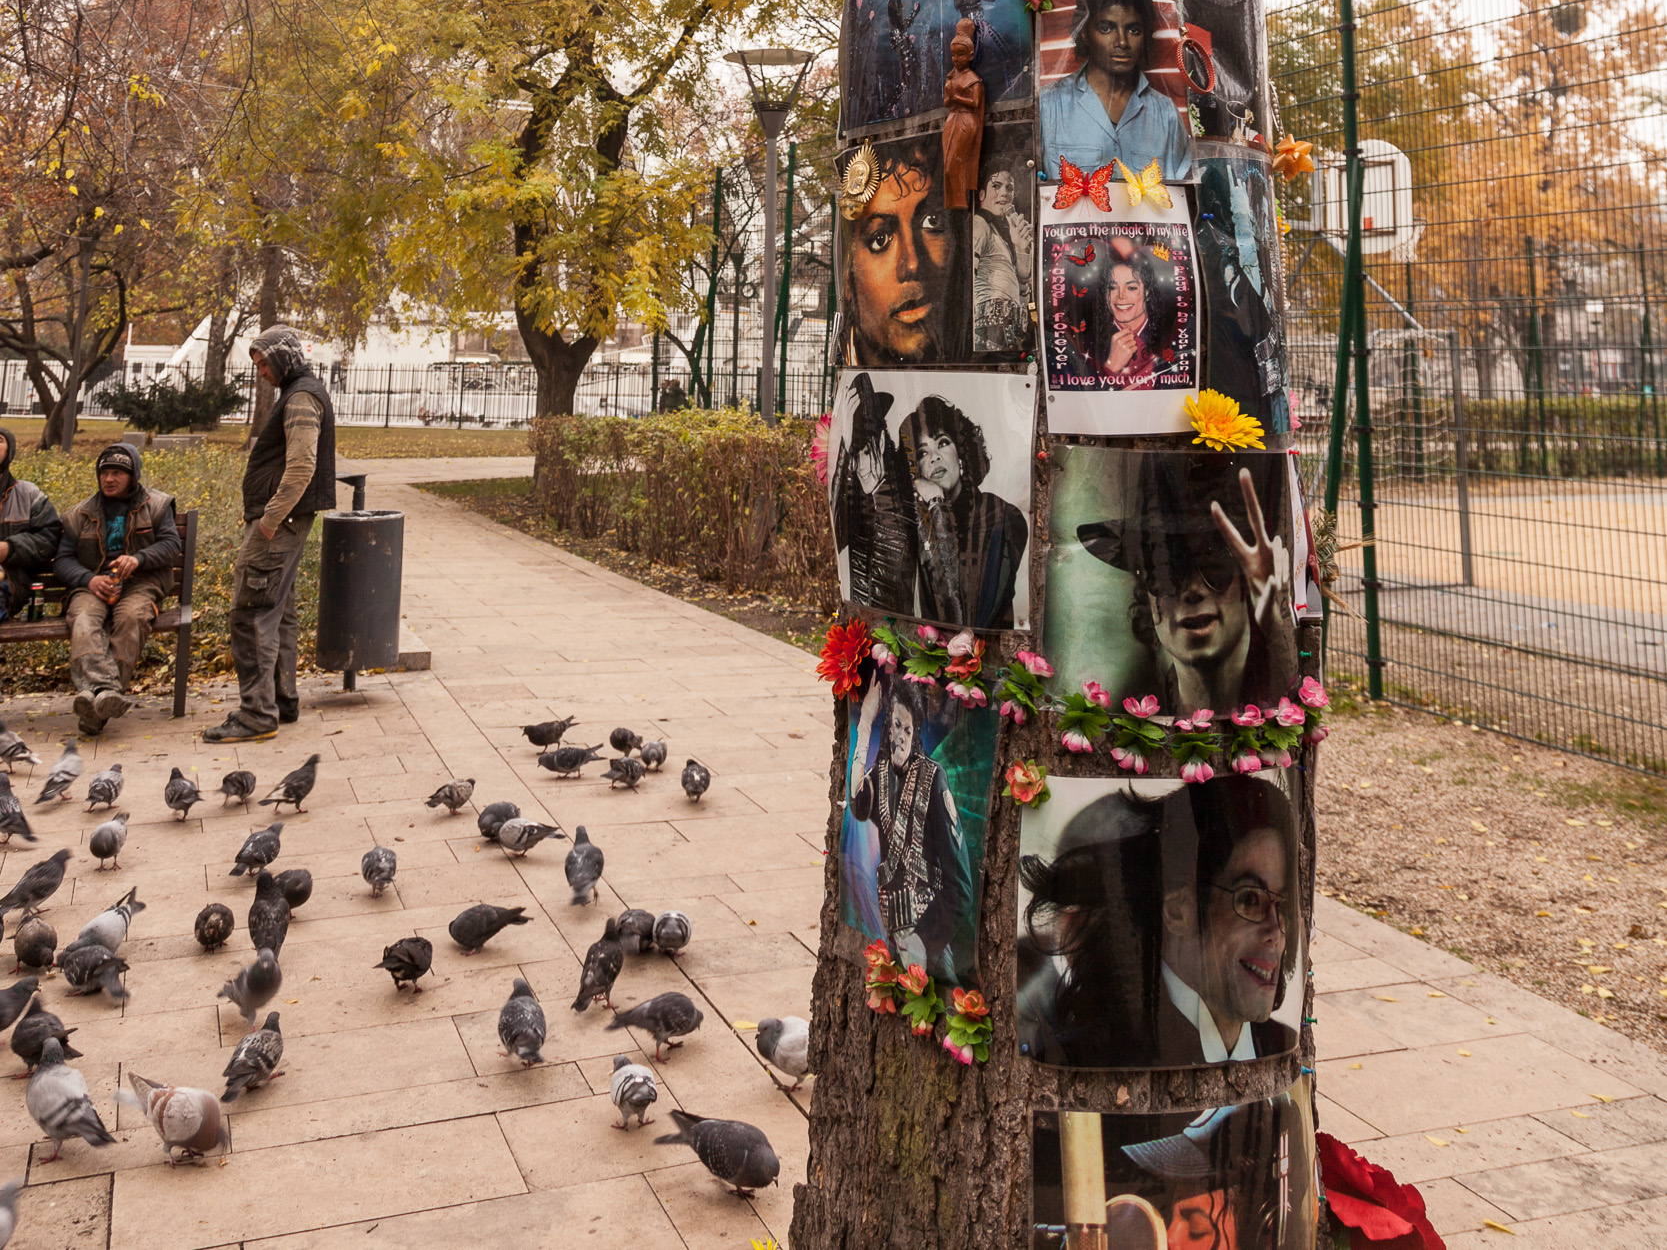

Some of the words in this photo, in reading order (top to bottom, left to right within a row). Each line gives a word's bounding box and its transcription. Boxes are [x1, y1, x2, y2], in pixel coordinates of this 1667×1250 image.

[1044, 227, 1064, 238] You
[1065, 226, 1087, 237] are
[1089, 224, 1109, 237] the
[1111, 223, 1145, 238] magic
[1146, 224, 1156, 236] in
[1157, 226, 1172, 238] my
[1173, 224, 1188, 237] life
[1051, 268, 1066, 306] angel
[1176, 296, 1189, 307] to
[1177, 312, 1189, 323] be
[1053, 313, 1068, 369] forever
[1060, 374, 1065, 385] I
[1067, 373, 1095, 386] love
[1098, 375, 1125, 388] you
[1127, 374, 1157, 388] very
